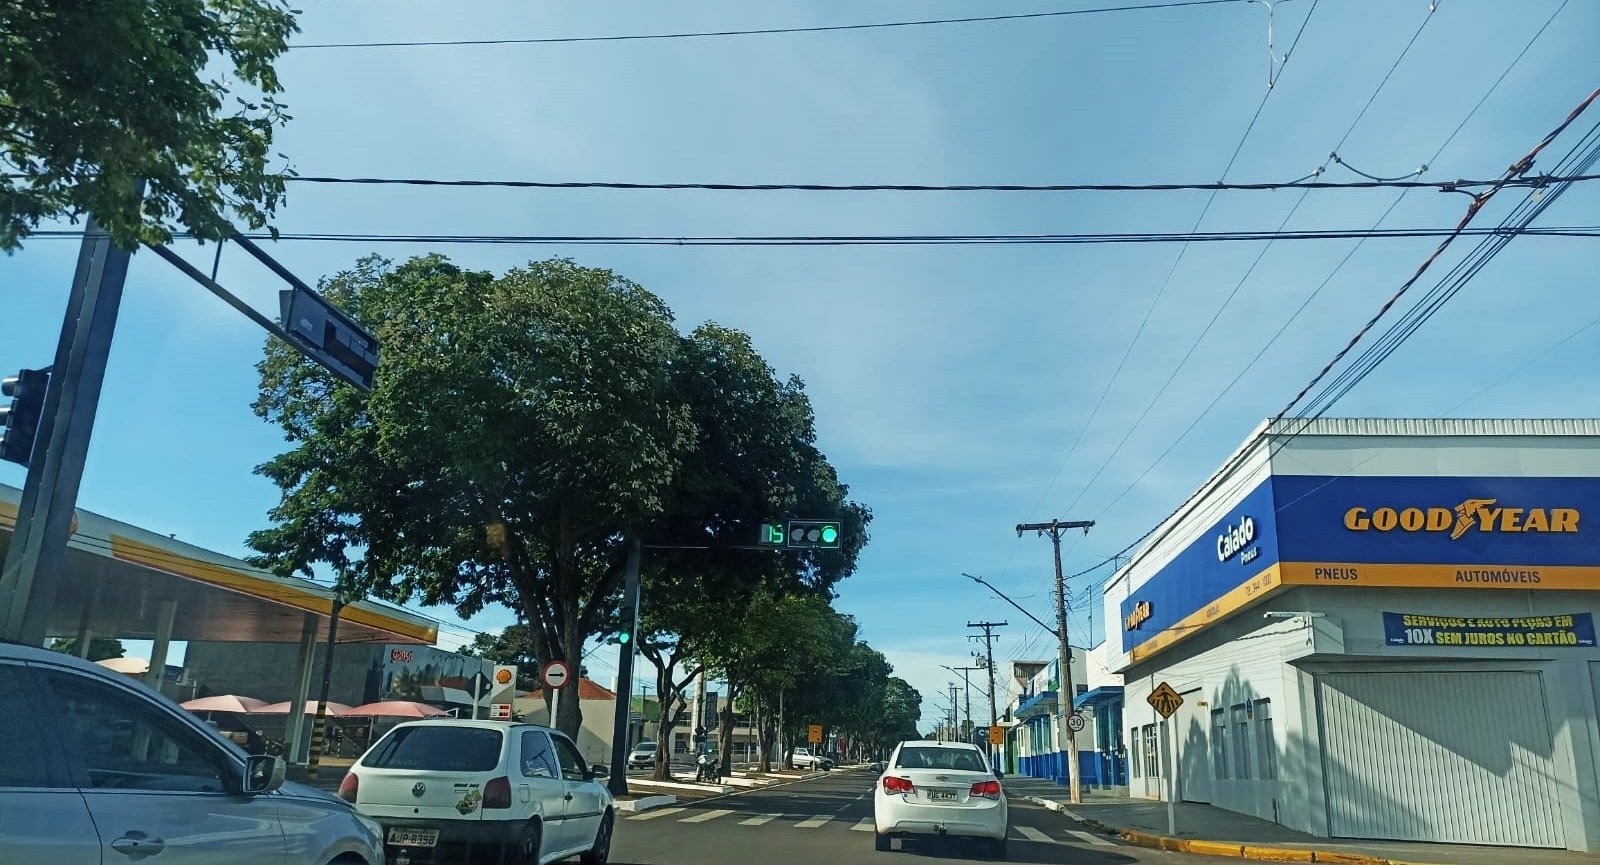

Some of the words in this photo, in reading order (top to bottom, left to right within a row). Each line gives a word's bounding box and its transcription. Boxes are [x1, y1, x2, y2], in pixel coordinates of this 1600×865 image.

[1344, 503, 1580, 537] GOODYEAR
[769, 524, 784, 543] 15
[1217, 516, 1254, 562] Caiado
[1314, 568, 1358, 580] PNEUS
[1455, 568, 1541, 584] AUTOMÓVEIS
[1555, 616, 1574, 627] EM
[1405, 628, 1435, 644] 10X
[1436, 632, 1462, 645] SEM
[1465, 632, 1505, 645] JUROS
[1506, 632, 1525, 645] NO
[1526, 629, 1577, 645] CARTÃO
